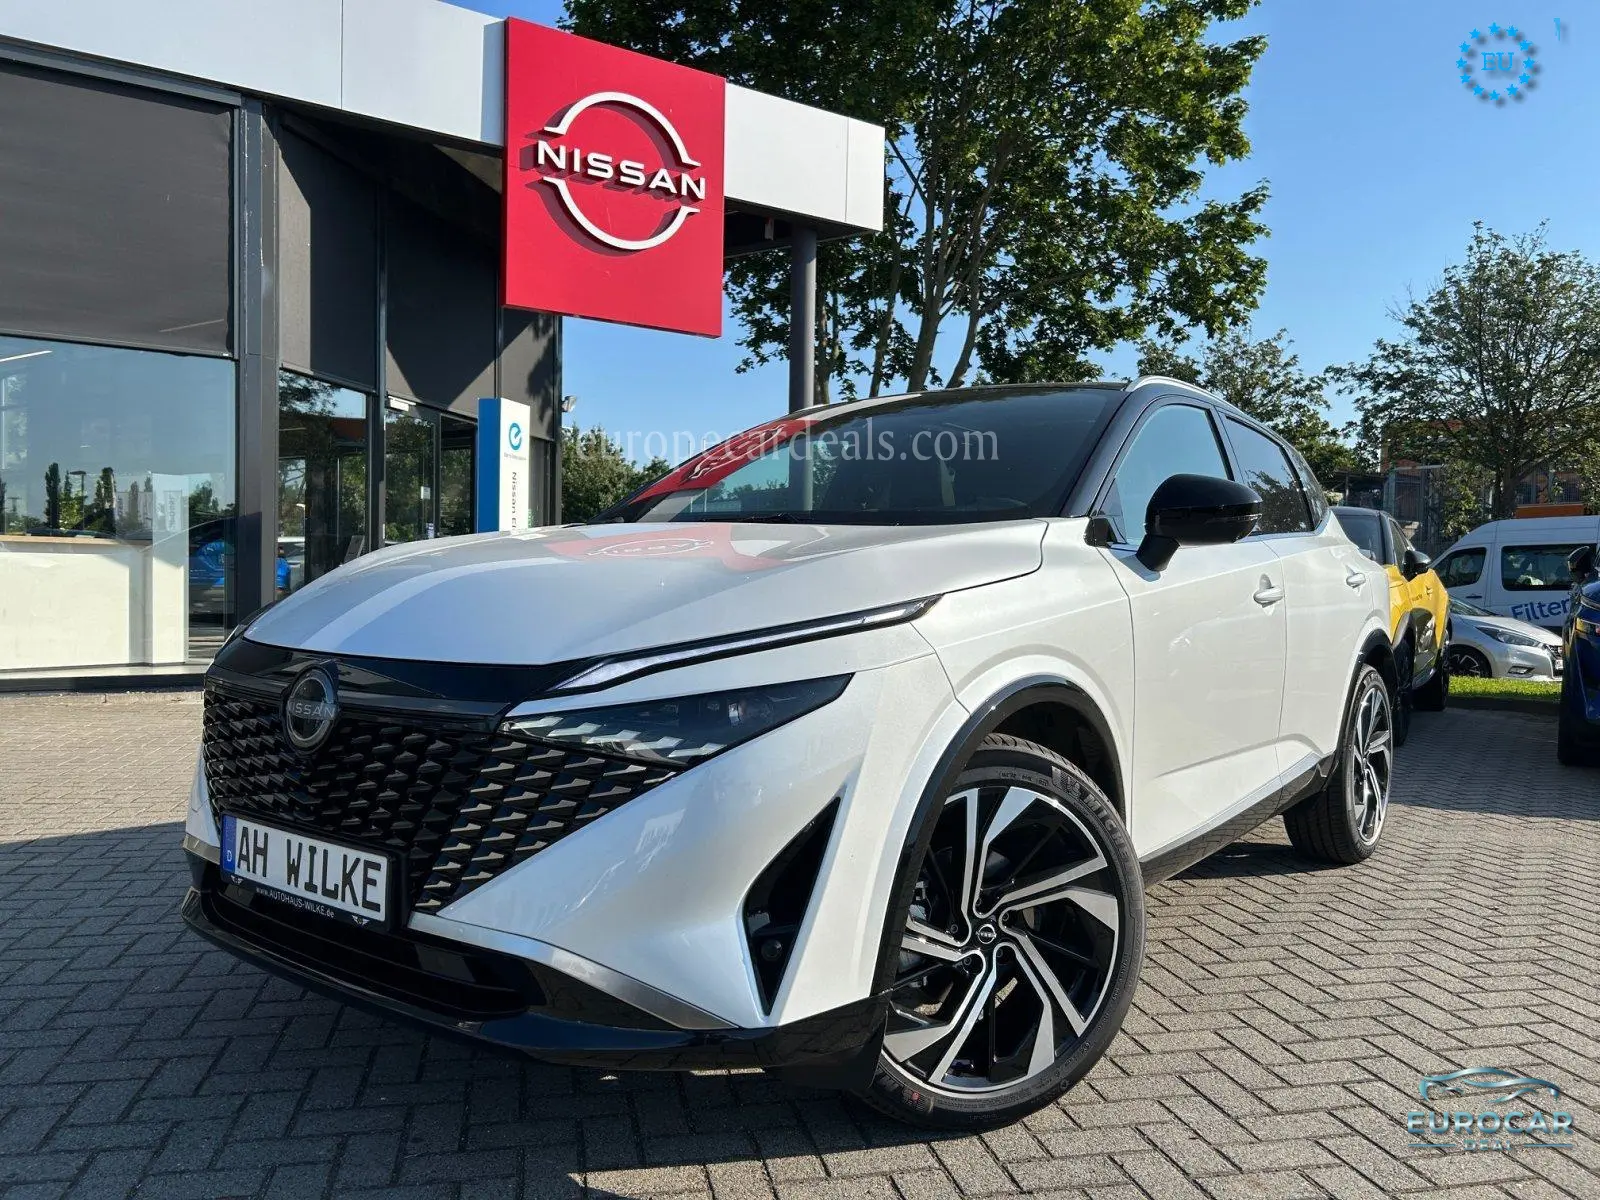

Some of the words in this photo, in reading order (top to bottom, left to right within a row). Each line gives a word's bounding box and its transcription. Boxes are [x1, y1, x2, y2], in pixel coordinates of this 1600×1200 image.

[537, 140, 706, 200] NISSAN
[1510, 597, 1570, 622] Filter
[286, 699, 336, 718] NISSAN
[226, 849, 233, 862] D
[237, 826, 269, 878] AH
[286, 838, 382, 913] WILKE
[255, 886, 335, 919] www.AUTOHAUS-WILKE.de
